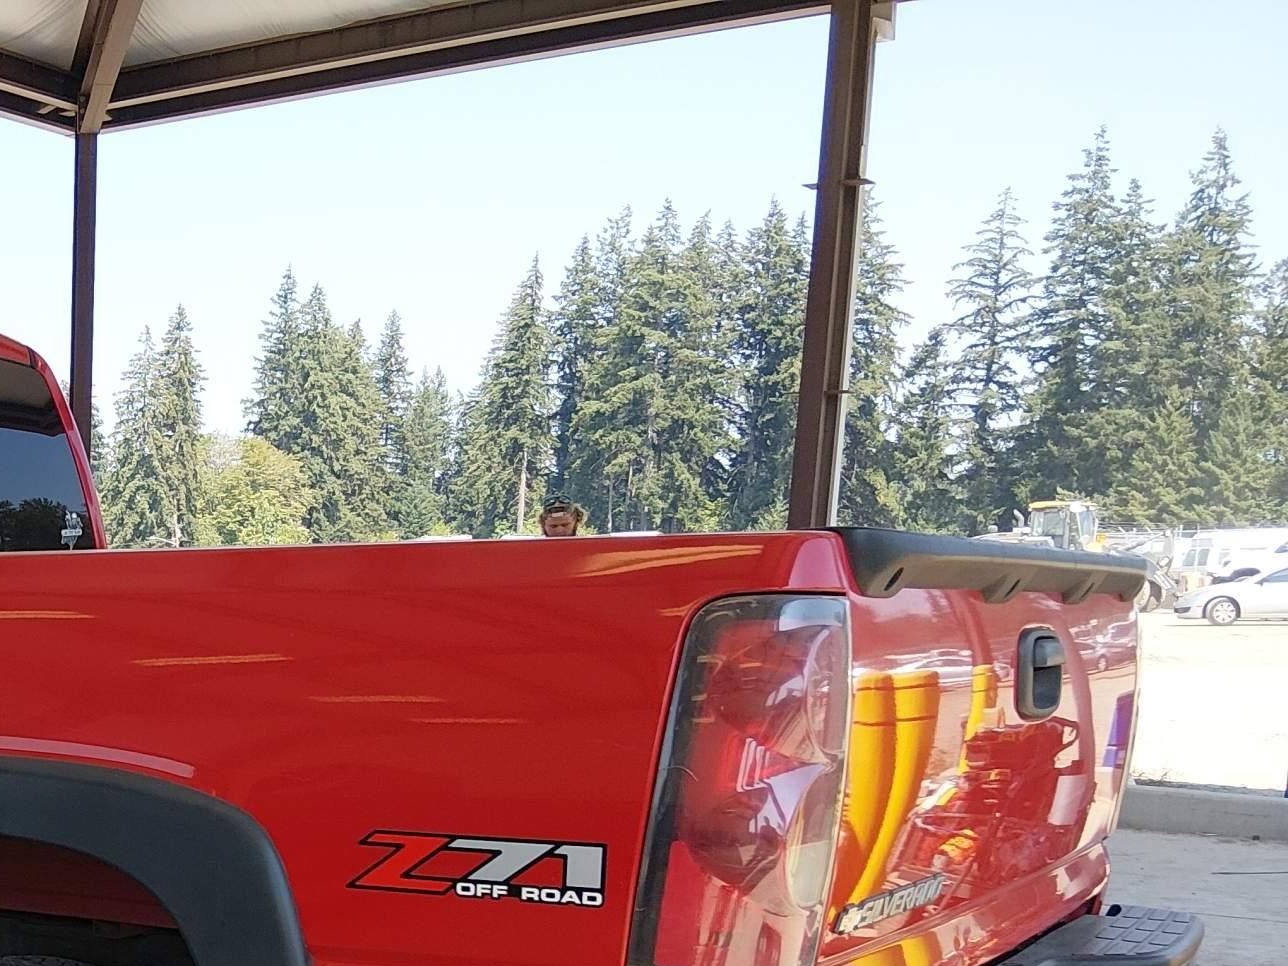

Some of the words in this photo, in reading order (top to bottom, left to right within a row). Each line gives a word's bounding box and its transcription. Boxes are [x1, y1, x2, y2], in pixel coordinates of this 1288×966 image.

[346, 829, 608, 896] Z71
[455, 881, 510, 899] OFF
[520, 886, 604, 907] ROAD
